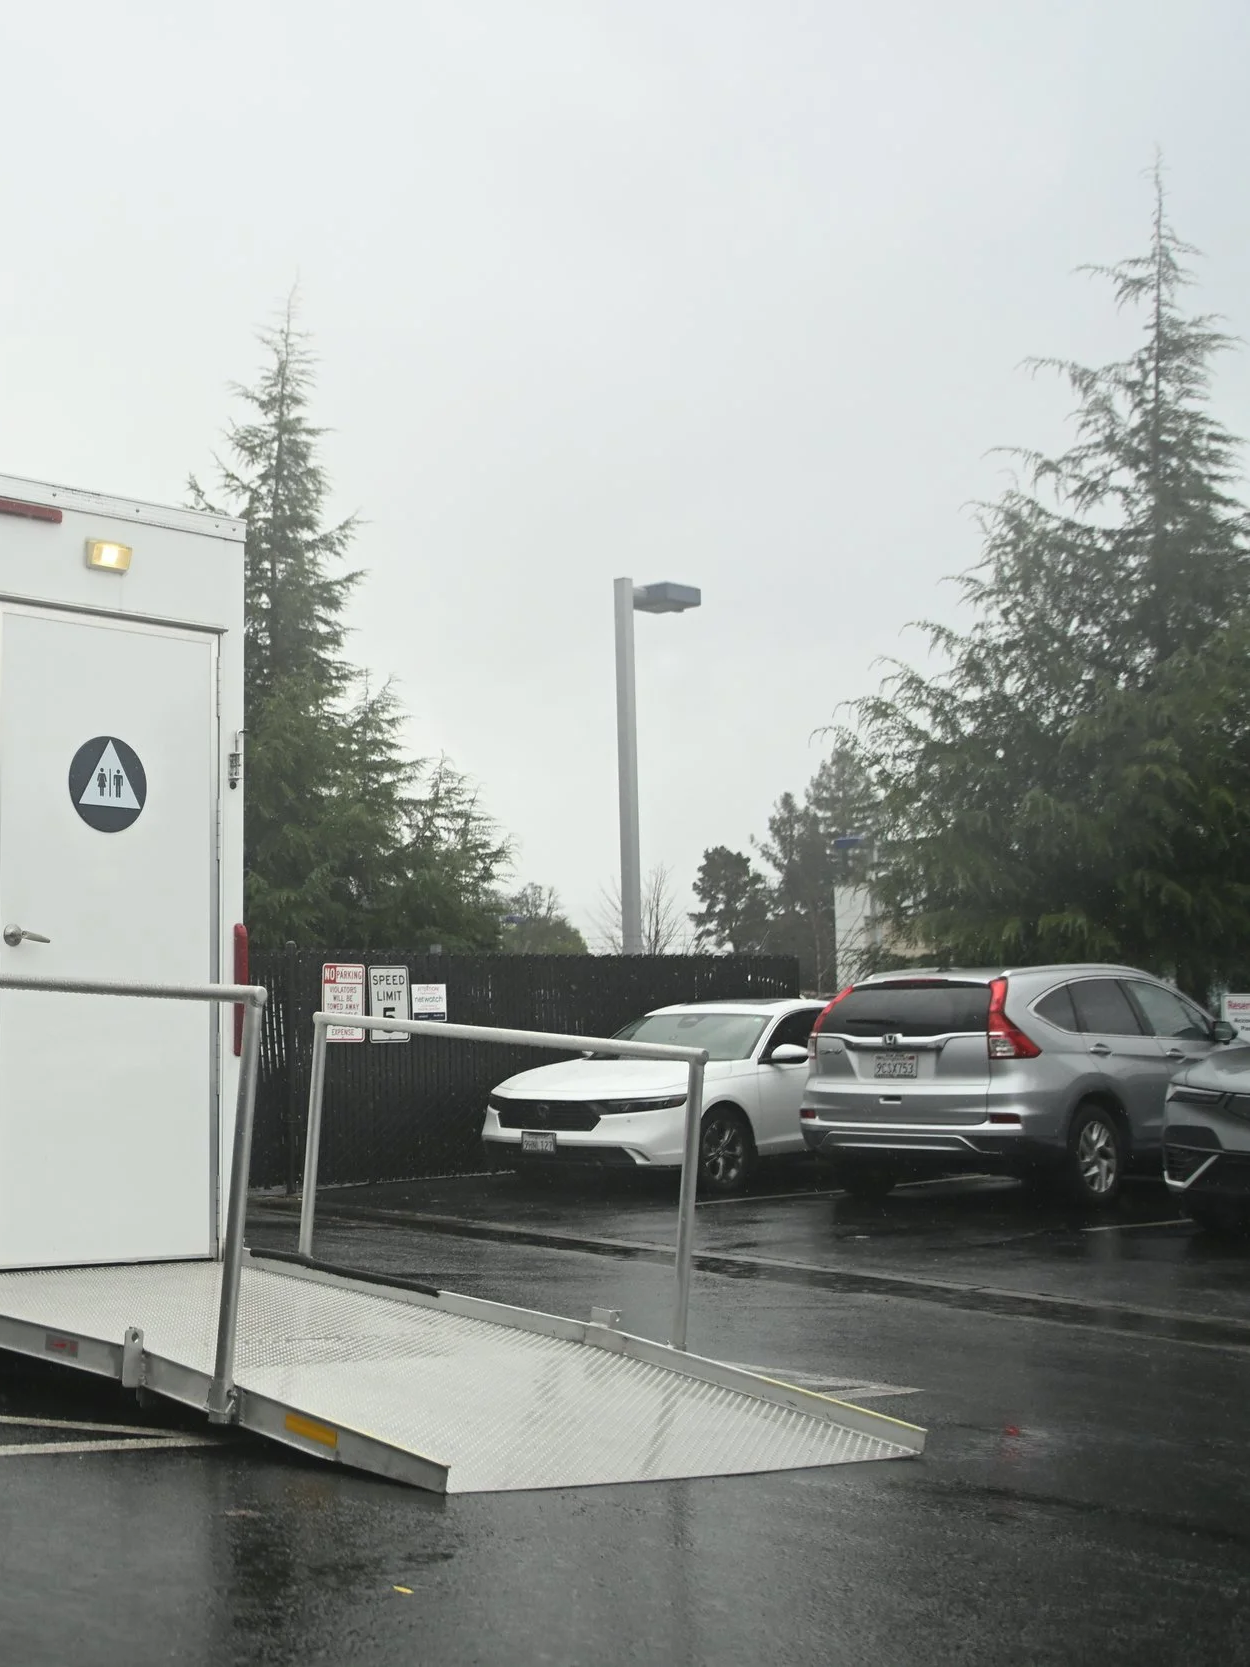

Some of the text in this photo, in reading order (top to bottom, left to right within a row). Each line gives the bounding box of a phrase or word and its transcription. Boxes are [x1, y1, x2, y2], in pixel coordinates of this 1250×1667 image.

[324, 967, 362, 981] NO PARKING
[372, 975, 405, 986] SPEED
[329, 986, 357, 994] VIOLATORS
[333, 994, 344, 1002] WILL
[377, 991, 402, 1002] LIMIT
[345, 1003, 360, 1011] AWAY
[331, 1028, 355, 1036] EXPENSE
